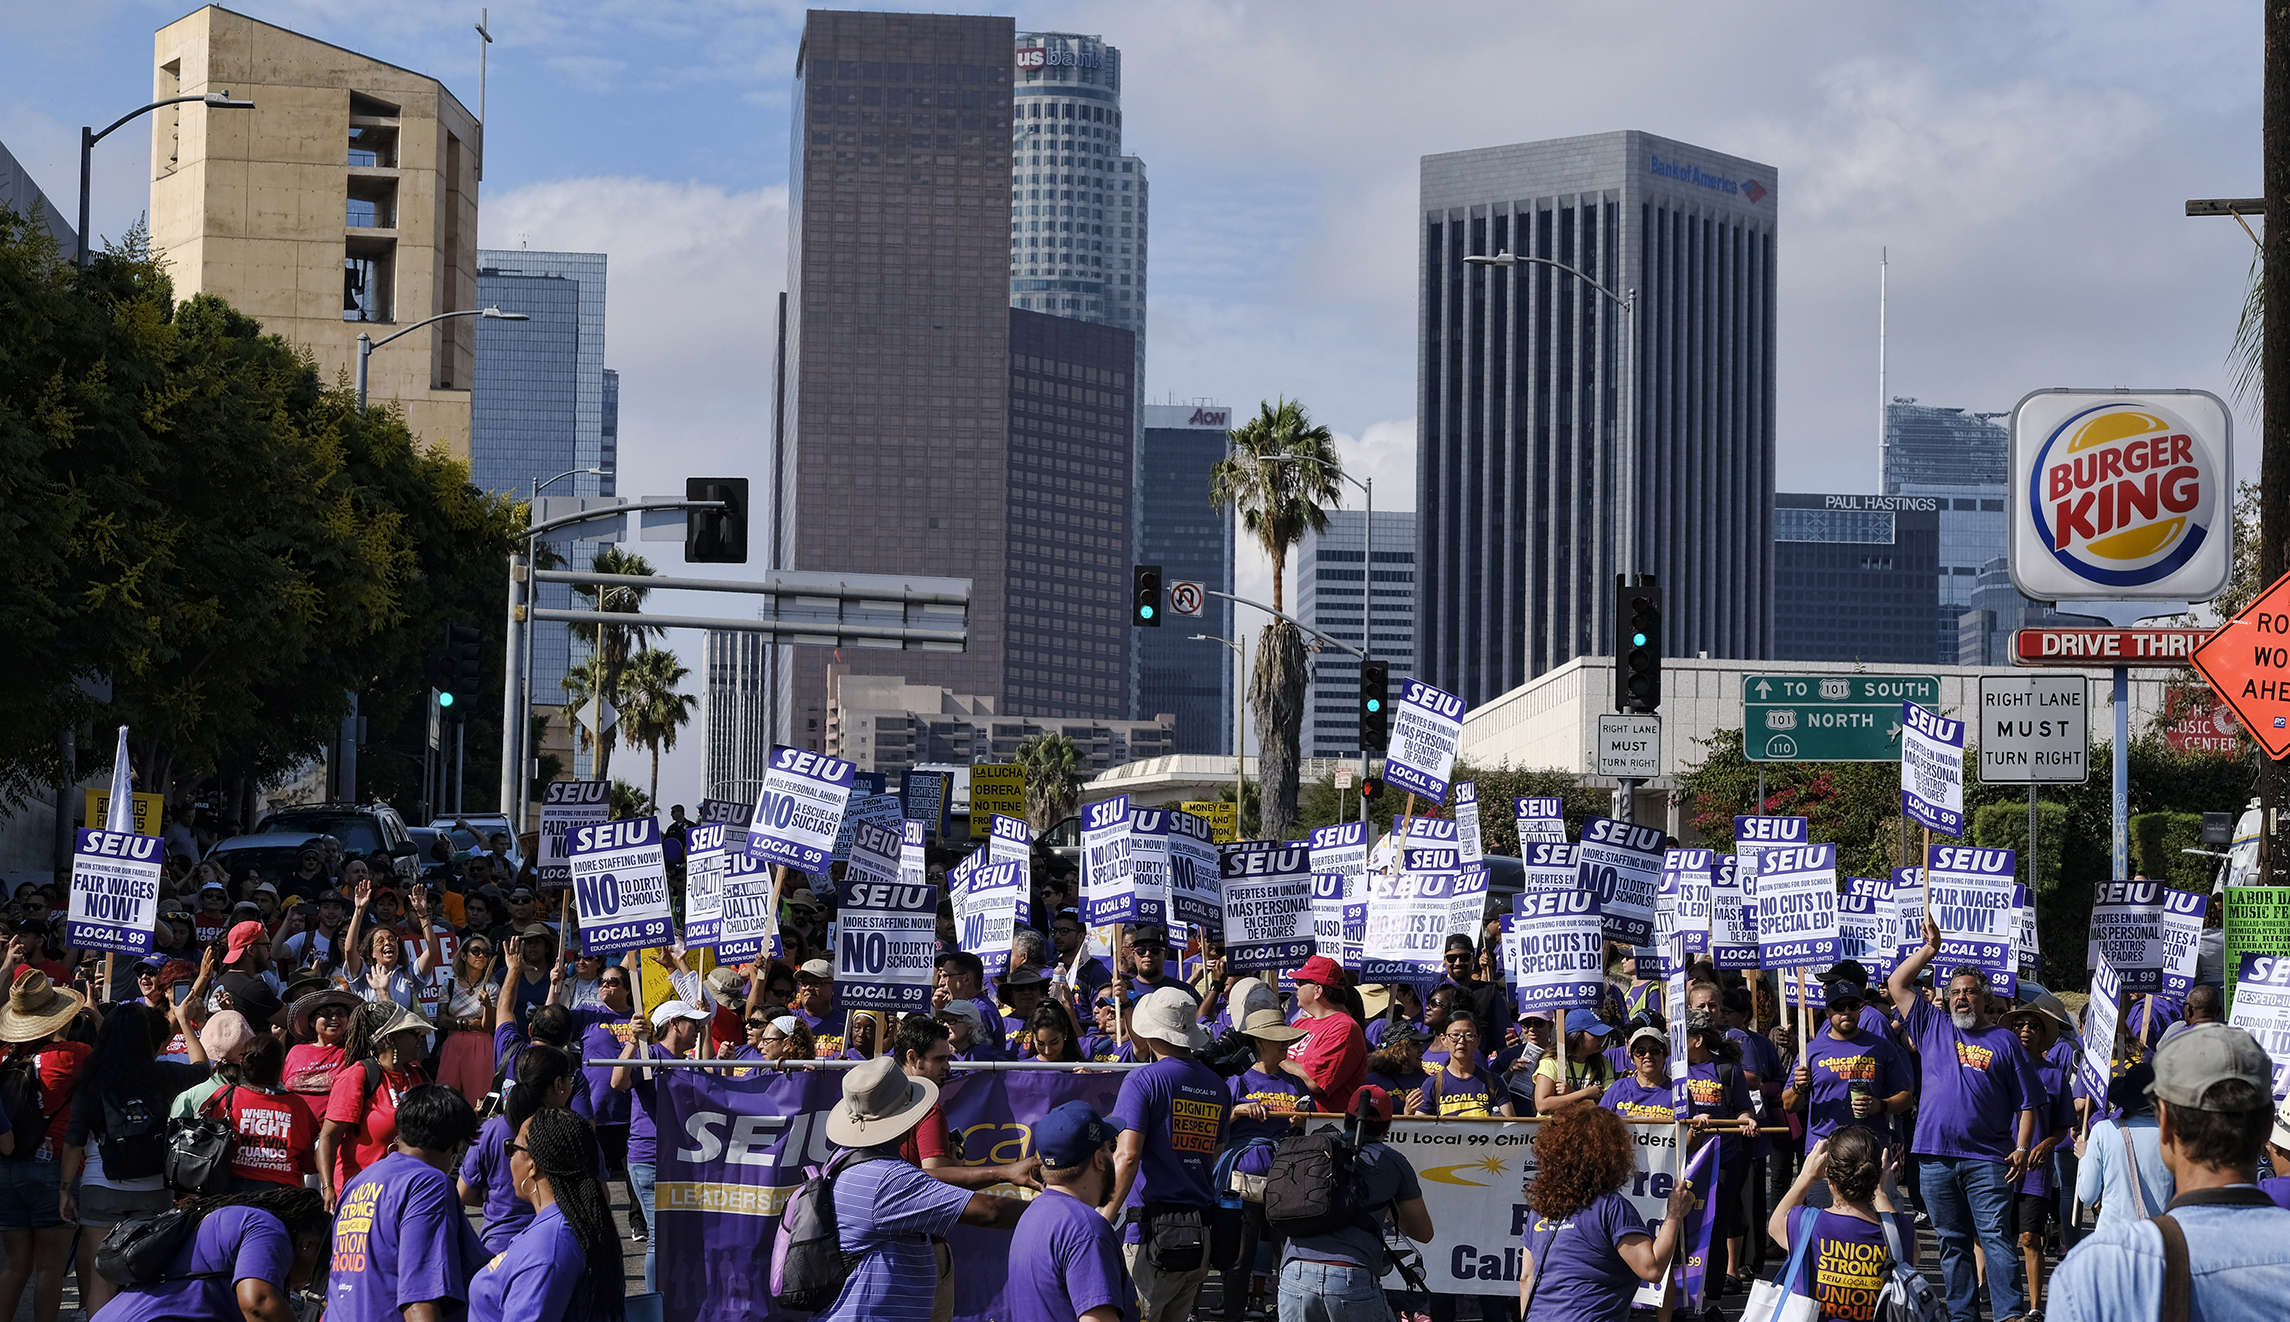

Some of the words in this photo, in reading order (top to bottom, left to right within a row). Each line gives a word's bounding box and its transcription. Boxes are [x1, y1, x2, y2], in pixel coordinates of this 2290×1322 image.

[1650, 155, 1678, 179] Bank
[1681, 164, 1691, 182] of
[1692, 167, 1737, 195] America
[2050, 434, 2193, 502] BURGER
[1826, 496, 1861, 509] PAUL
[1865, 497, 1936, 511] HASTINGS
[2056, 466, 2199, 550] KING
[2042, 634, 2120, 656] DRIVE
[1784, 684, 1807, 696] TO
[1825, 685, 1844, 695] 101
[1864, 683, 1929, 697] SOUTH
[1986, 693, 2032, 706] RIGHT
[2040, 693, 2080, 706] LANE
[1772, 716, 1791, 725] 101
[1808, 714, 1874, 727] NORTH
[1603, 724, 1628, 734] RIGHT
[1633, 725, 1657, 734] LANE
[1998, 721, 2069, 737] MUST
[1612, 741, 1647, 752] MUST
[1773, 743, 1791, 753] 110
[2185, 737, 2236, 750] CENTER
[776, 749, 848, 781] SEIU
[1602, 759, 1627, 768] TURN
[1631, 759, 1656, 768] RIGHT
[1986, 752, 2027, 764] TURN
[2036, 752, 2081, 764] RIGHT
[988, 768, 1023, 778] LUCHA
[784, 781, 817, 799] PERSONAL
[819, 790, 845, 804] AHORA!
[975, 785, 1021, 795] OBRERA
[756, 790, 795, 829] NO
[795, 803, 801, 812] A
[802, 804, 840, 823] ESCUELAS
[975, 801, 989, 810] NO
[992, 802, 1021, 811] TIENE
[792, 813, 836, 836] SUCIAS!
[577, 820, 648, 851] SEIU
[83, 832, 156, 859] SEIU
[753, 837, 799, 857] LOCAL
[803, 850, 822, 863] 99
[574, 861, 597, 873] MORE
[599, 854, 636, 870] STAFFING
[638, 852, 661, 863] NOW!
[1228, 850, 1300, 875] SEIU
[1935, 848, 2007, 872] SEIU
[132, 869, 155, 878] FAMILIES
[74, 874, 105, 893] FAIR
[108, 878, 154, 900] WAGES
[619, 880, 631, 893] TO
[634, 876, 662, 891] DIRTY
[1985, 880, 2009, 888] FAMILIES
[576, 874, 620, 918] NO
[621, 890, 664, 907] SCHOOLS!
[847, 884, 928, 908] SEIU
[1227, 887, 1266, 903] ¡FUERTES
[1268, 887, 1278, 897] EN
[1280, 882, 1311, 896] UNIÓN!
[1929, 888, 1958, 906] FAIR
[1961, 890, 2009, 910] WAGES
[2228, 891, 2273, 904] LABOR
[85, 893, 140, 922] NOW!
[1227, 900, 1253, 918] MÁS
[1256, 898, 1312, 916] PERSONAL
[1522, 892, 1592, 916] SEIU
[1940, 906, 1995, 933] NOW!
[2228, 906, 2269, 919] MUSIC
[843, 917, 868, 927] MORE
[870, 918, 909, 928] STAFFING
[912, 918, 935, 929] NOW!
[1244, 917, 1255, 928] EN
[1258, 914, 1297, 927] CENTROS
[74, 926, 124, 941] LOCAL
[128, 932, 145, 944] 99
[590, 925, 641, 943] LOCAL
[646, 922, 664, 935] 99
[1248, 929, 1258, 940] DE
[1261, 926, 1295, 938] PADRES
[888, 942, 900, 955] TO
[902, 942, 933, 955] DIRTY
[1234, 947, 1284, 960] LOCAL
[1290, 944, 1308, 956] 99
[1521, 936, 1540, 956] NO
[1543, 933, 1580, 953] CUTS
[1583, 933, 1600, 951] TO
[1983, 946, 2001, 957] 99
[842, 932, 886, 974] NO
[887, 956, 932, 968] SCHOOLS!
[1522, 953, 1576, 974] SPECIAL
[1580, 953, 1600, 970] ED!
[842, 985, 896, 999] LOCAL
[903, 988, 922, 1000] 99
[1526, 986, 1574, 1001] LOCAL
[1579, 985, 1596, 996] 99
[1818, 1055, 1875, 1068] education
[1830, 1063, 1875, 1072] workers
[1839, 1070, 1875, 1078] united
[1440, 1093, 1474, 1103] LOCAL
[1477, 1093, 1488, 1101] 99
[241, 1109, 273, 1119] WHEN
[275, 1111, 291, 1122] WE
[1175, 1101, 1220, 1118] DIGNITY
[240, 1118, 291, 1138] FIGHT
[1174, 1118, 1217, 1134] RESPECT
[240, 1135, 261, 1147] WE
[263, 1137, 288, 1149] WIN
[1174, 1136, 1214, 1151] JUSTICE
[1414, 1133, 1462, 1145] Local
[1468, 1135, 1489, 1146] 99
[238, 1146, 287, 1158] CUANDO
[1821, 1238, 1887, 1262] UNION
[1822, 1274, 1841, 1283] SEIU
